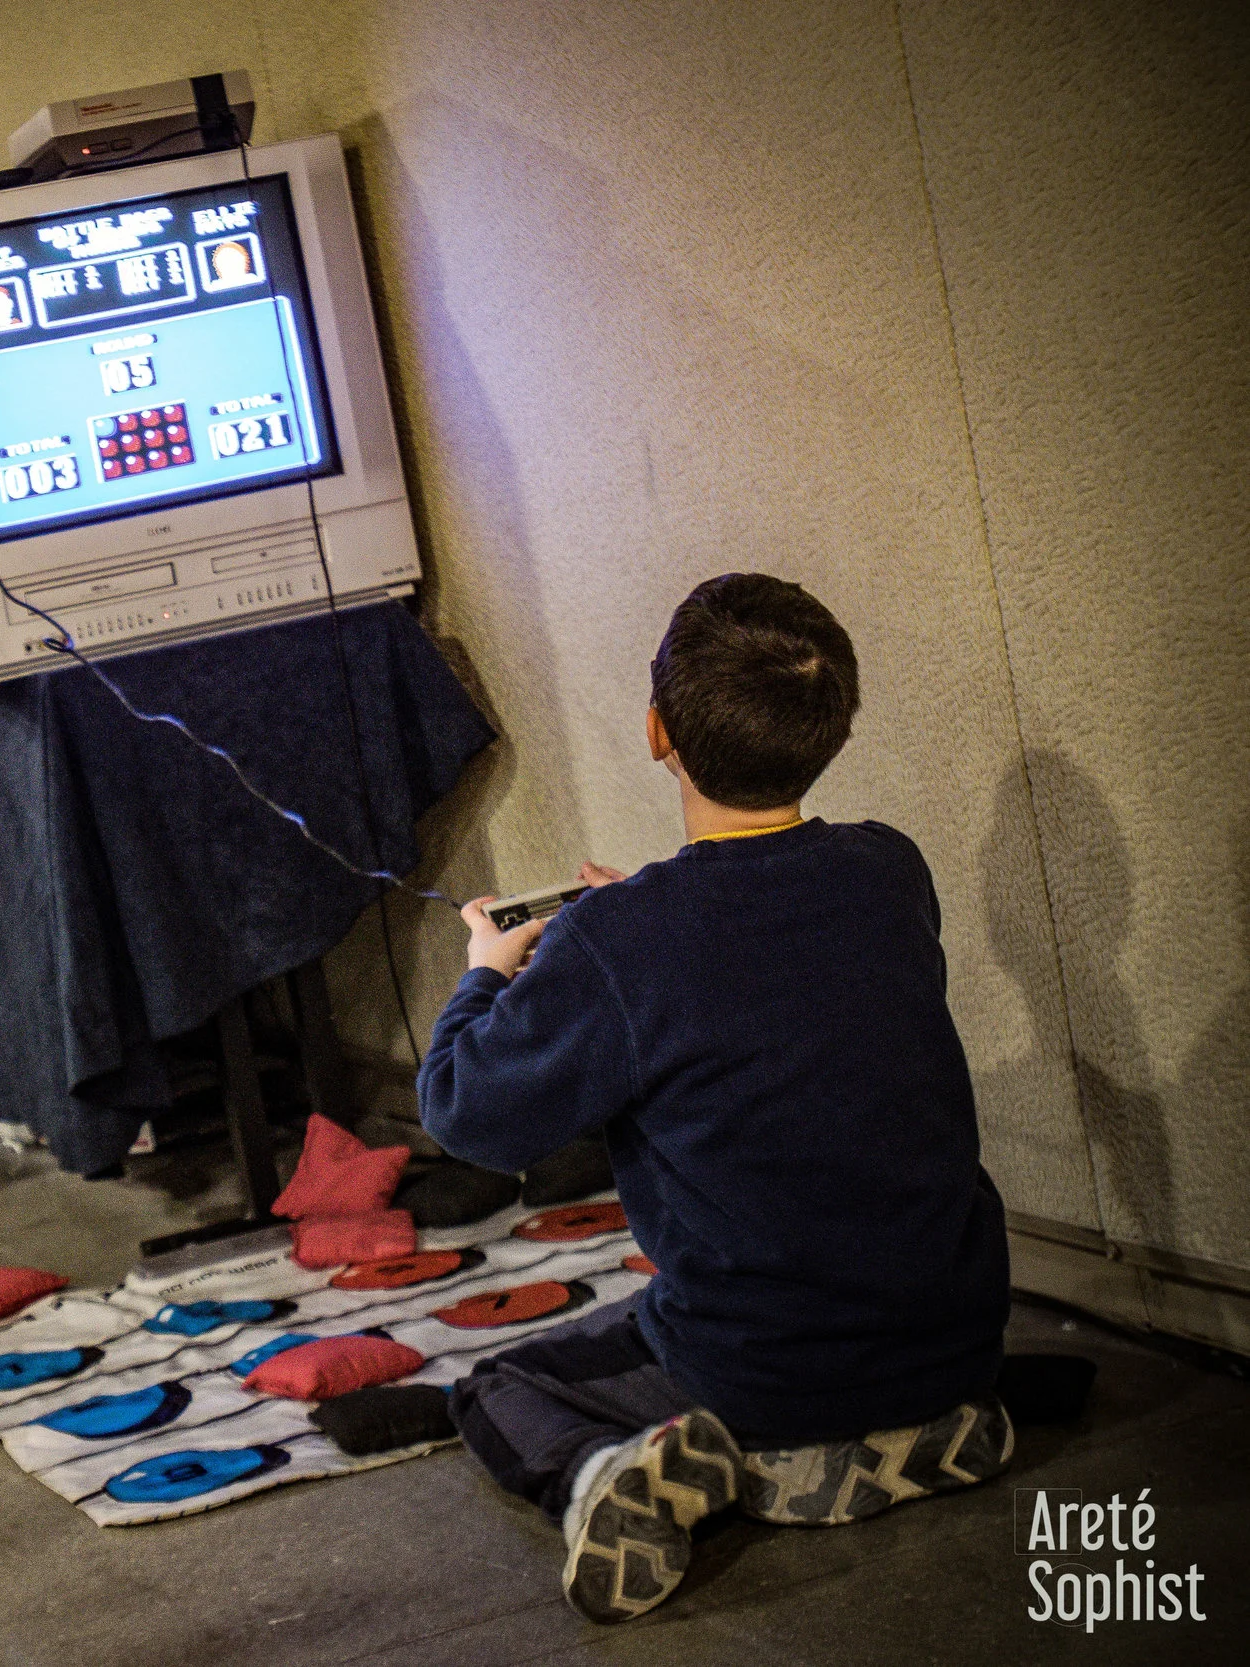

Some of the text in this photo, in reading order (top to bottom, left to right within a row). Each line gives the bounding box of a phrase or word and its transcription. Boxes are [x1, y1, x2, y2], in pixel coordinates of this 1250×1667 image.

[107, 356, 153, 391] 05
[214, 394, 277, 414] TOTAL
[4, 436, 66, 457] TOTAL
[215, 413, 288, 456] 021
[4, 456, 78, 499] 003
